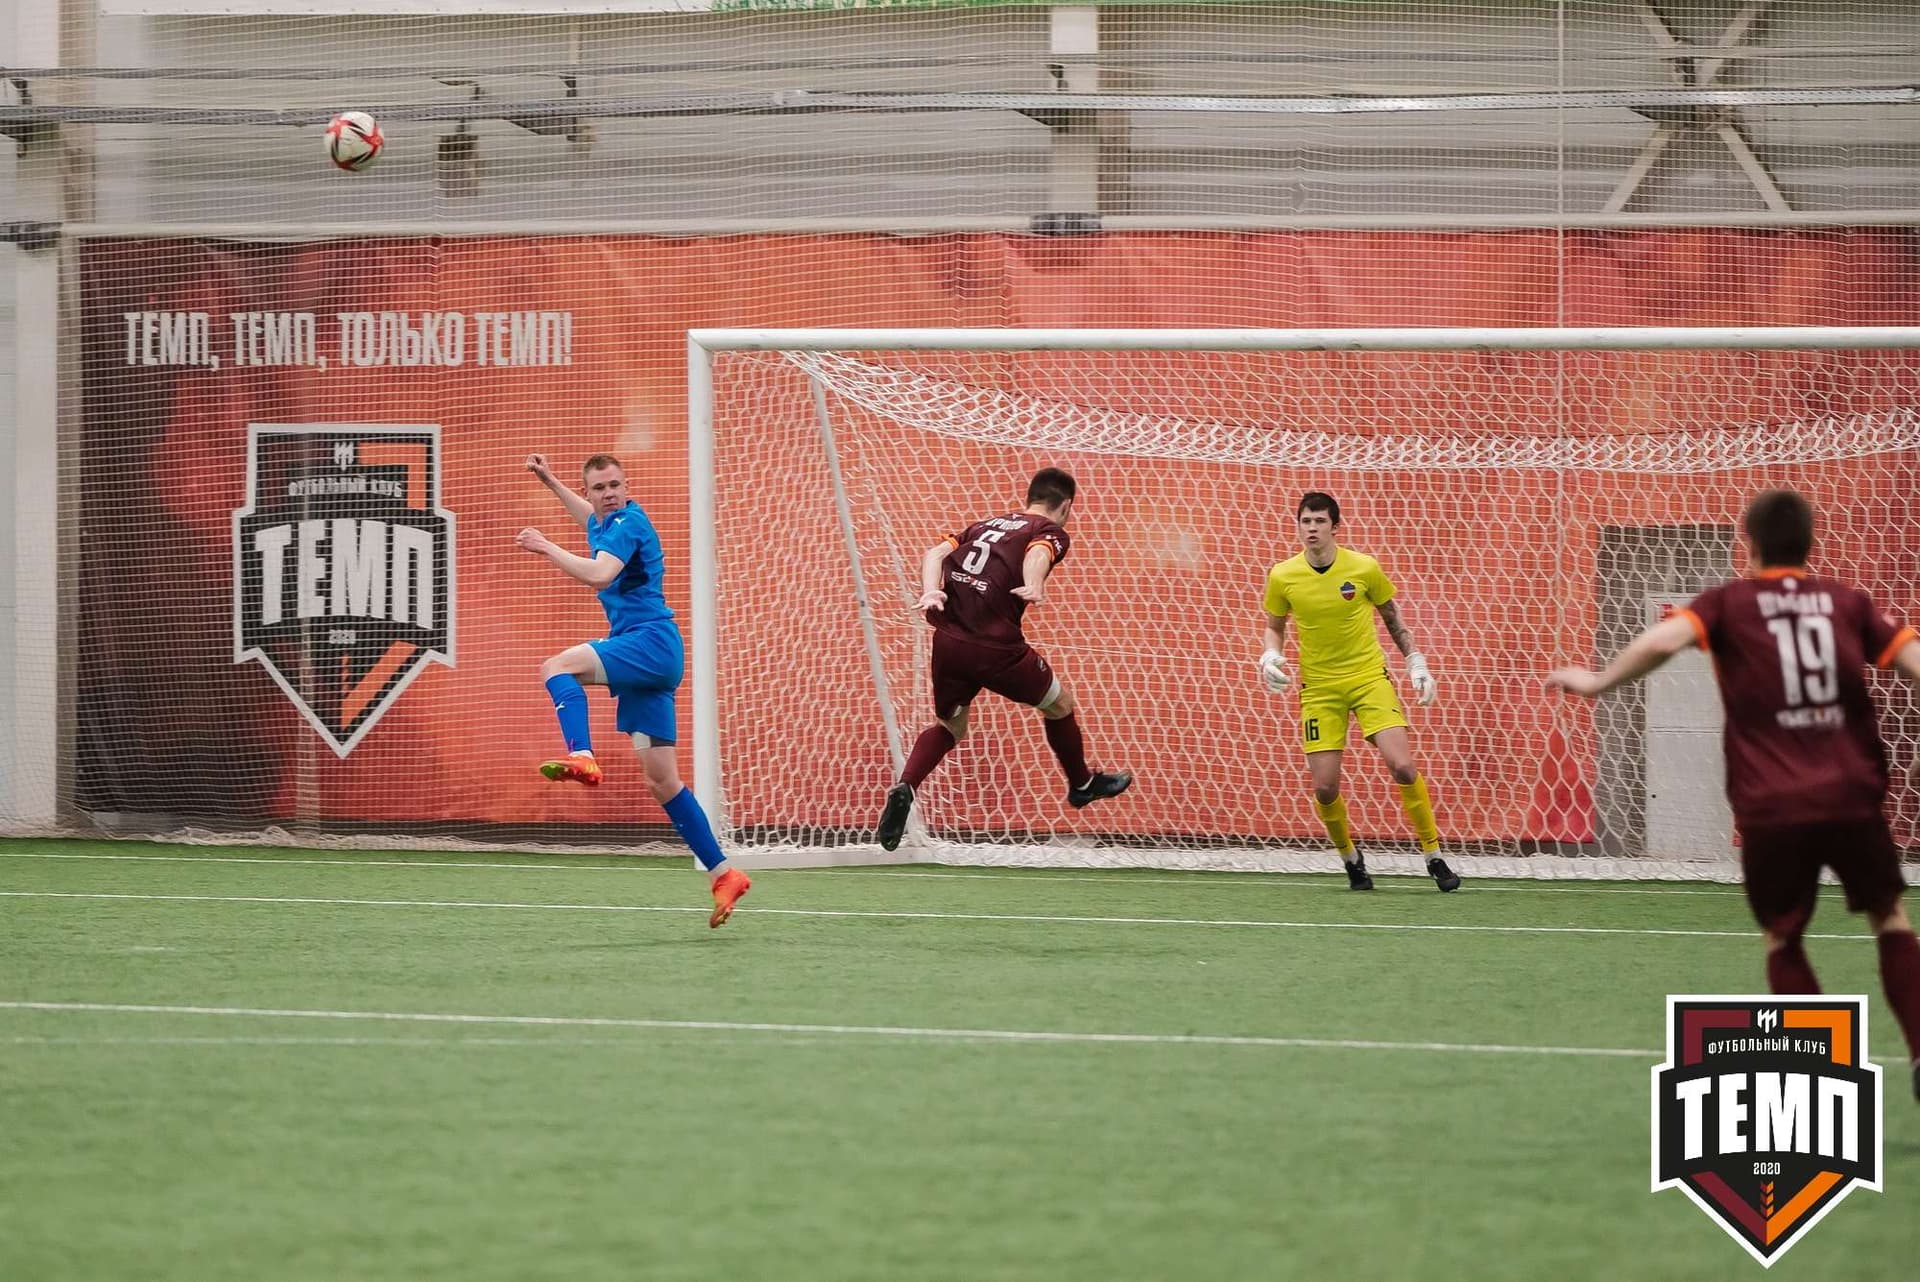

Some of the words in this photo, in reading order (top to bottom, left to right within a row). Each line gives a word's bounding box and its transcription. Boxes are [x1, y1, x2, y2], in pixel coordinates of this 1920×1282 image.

[124, 312, 219, 371] ТЕМП,
[230, 312, 327, 372] ТЕМП,
[337, 311, 465, 367] ТОЛЬКО
[474, 311, 572, 366] ТЕМП!
[254, 518, 433, 630] ТЕМП
[962, 530, 1006, 574] 5
[1768, 616, 1838, 706] 19
[1305, 718, 1320, 742] 16
